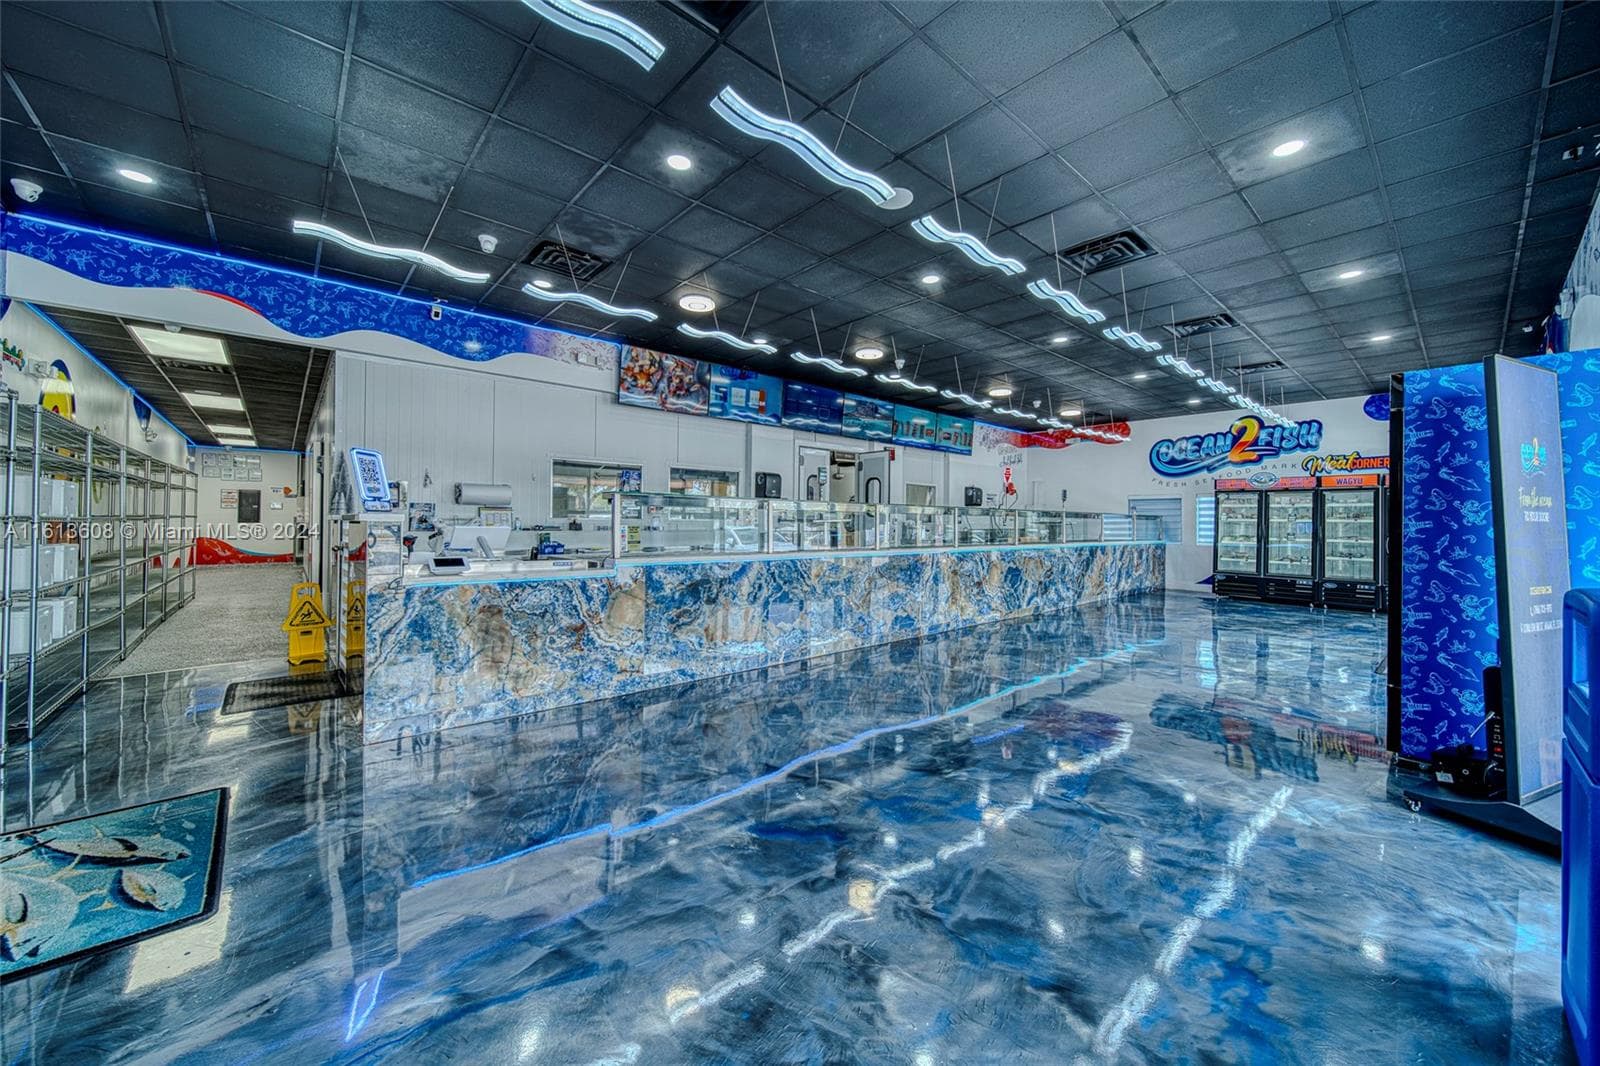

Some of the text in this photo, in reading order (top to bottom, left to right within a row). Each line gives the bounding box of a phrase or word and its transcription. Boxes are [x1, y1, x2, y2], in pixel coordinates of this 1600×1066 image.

[1157, 417, 1322, 463] OCEAN 2 FISH
[1302, 452, 1358, 475] Meat
[1336, 477, 1363, 485] WAGYU
